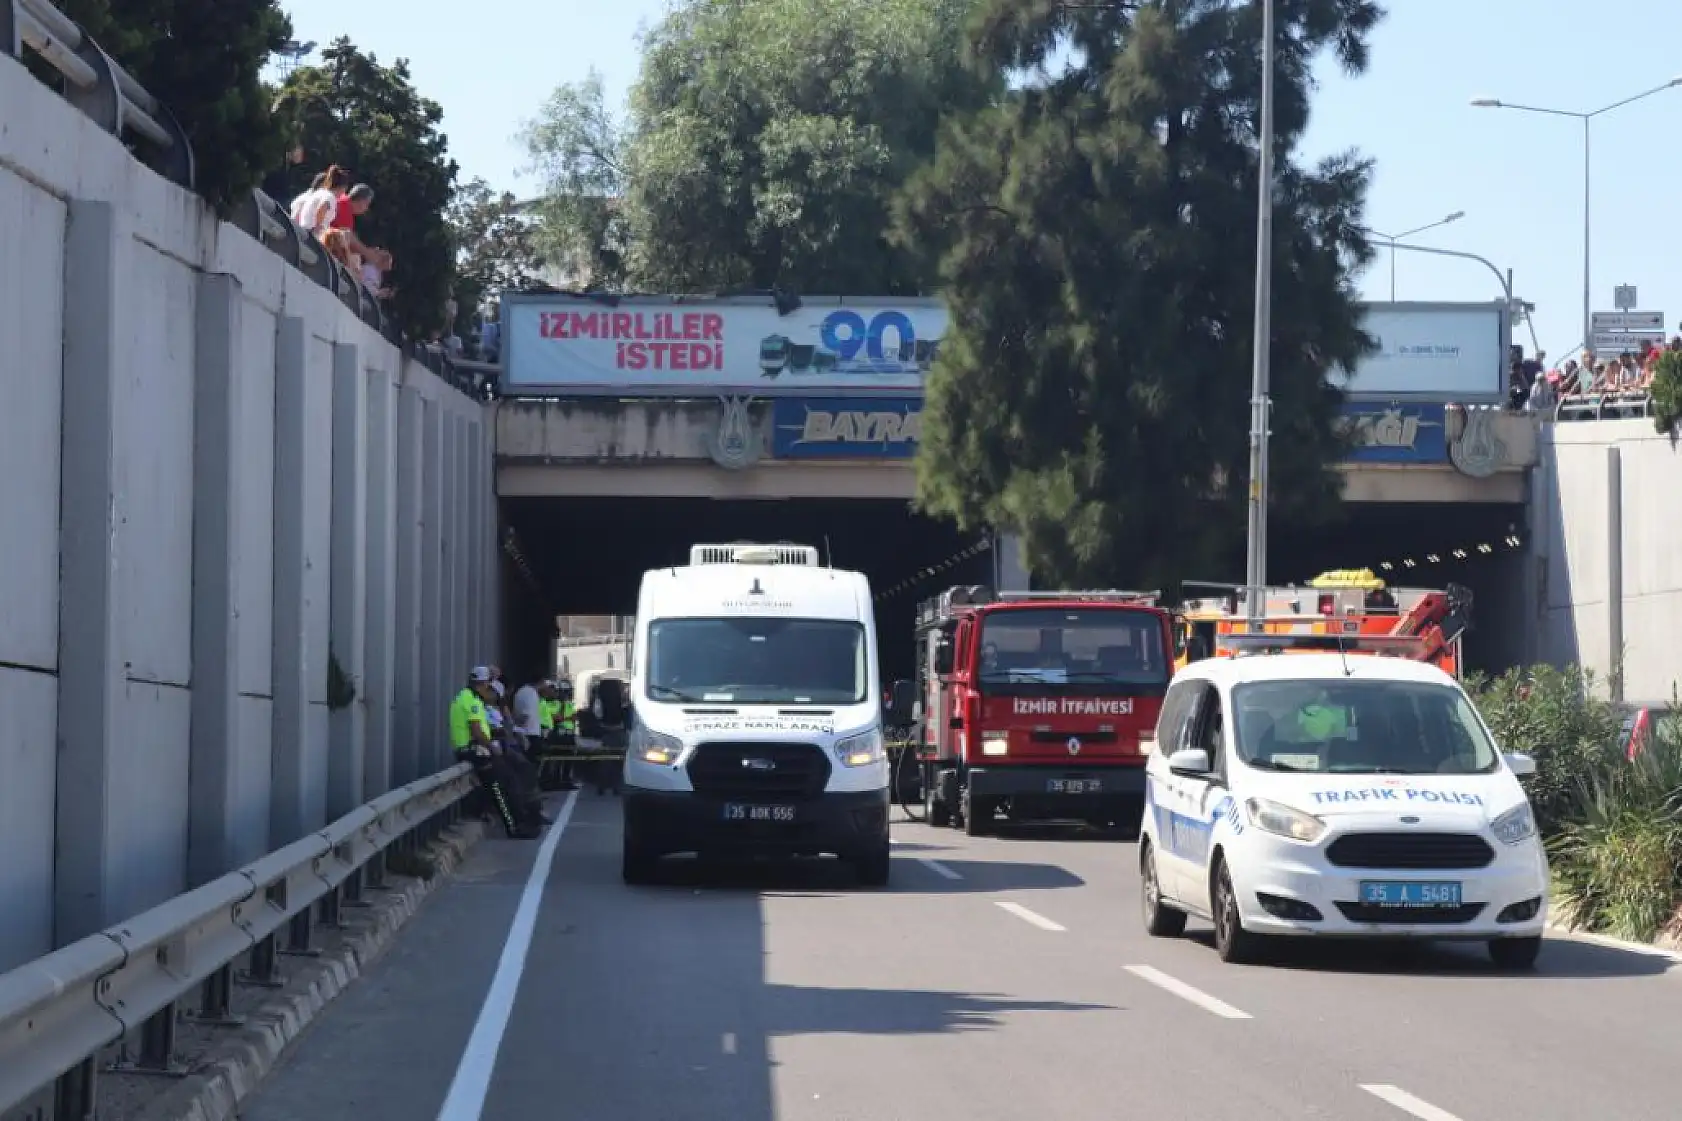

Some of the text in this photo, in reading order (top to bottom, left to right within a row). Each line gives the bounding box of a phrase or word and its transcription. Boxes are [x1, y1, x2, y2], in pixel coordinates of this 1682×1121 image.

[539, 311, 724, 340] İZMİRLİLER
[820, 310, 915, 361] 90
[616, 342, 724, 370] İSTEDİ
[804, 411, 924, 442] BAYRA
[1013, 696, 1134, 714] İZMİR İTFAİYESİ
[1367, 884, 1460, 901] 35 A 5481
